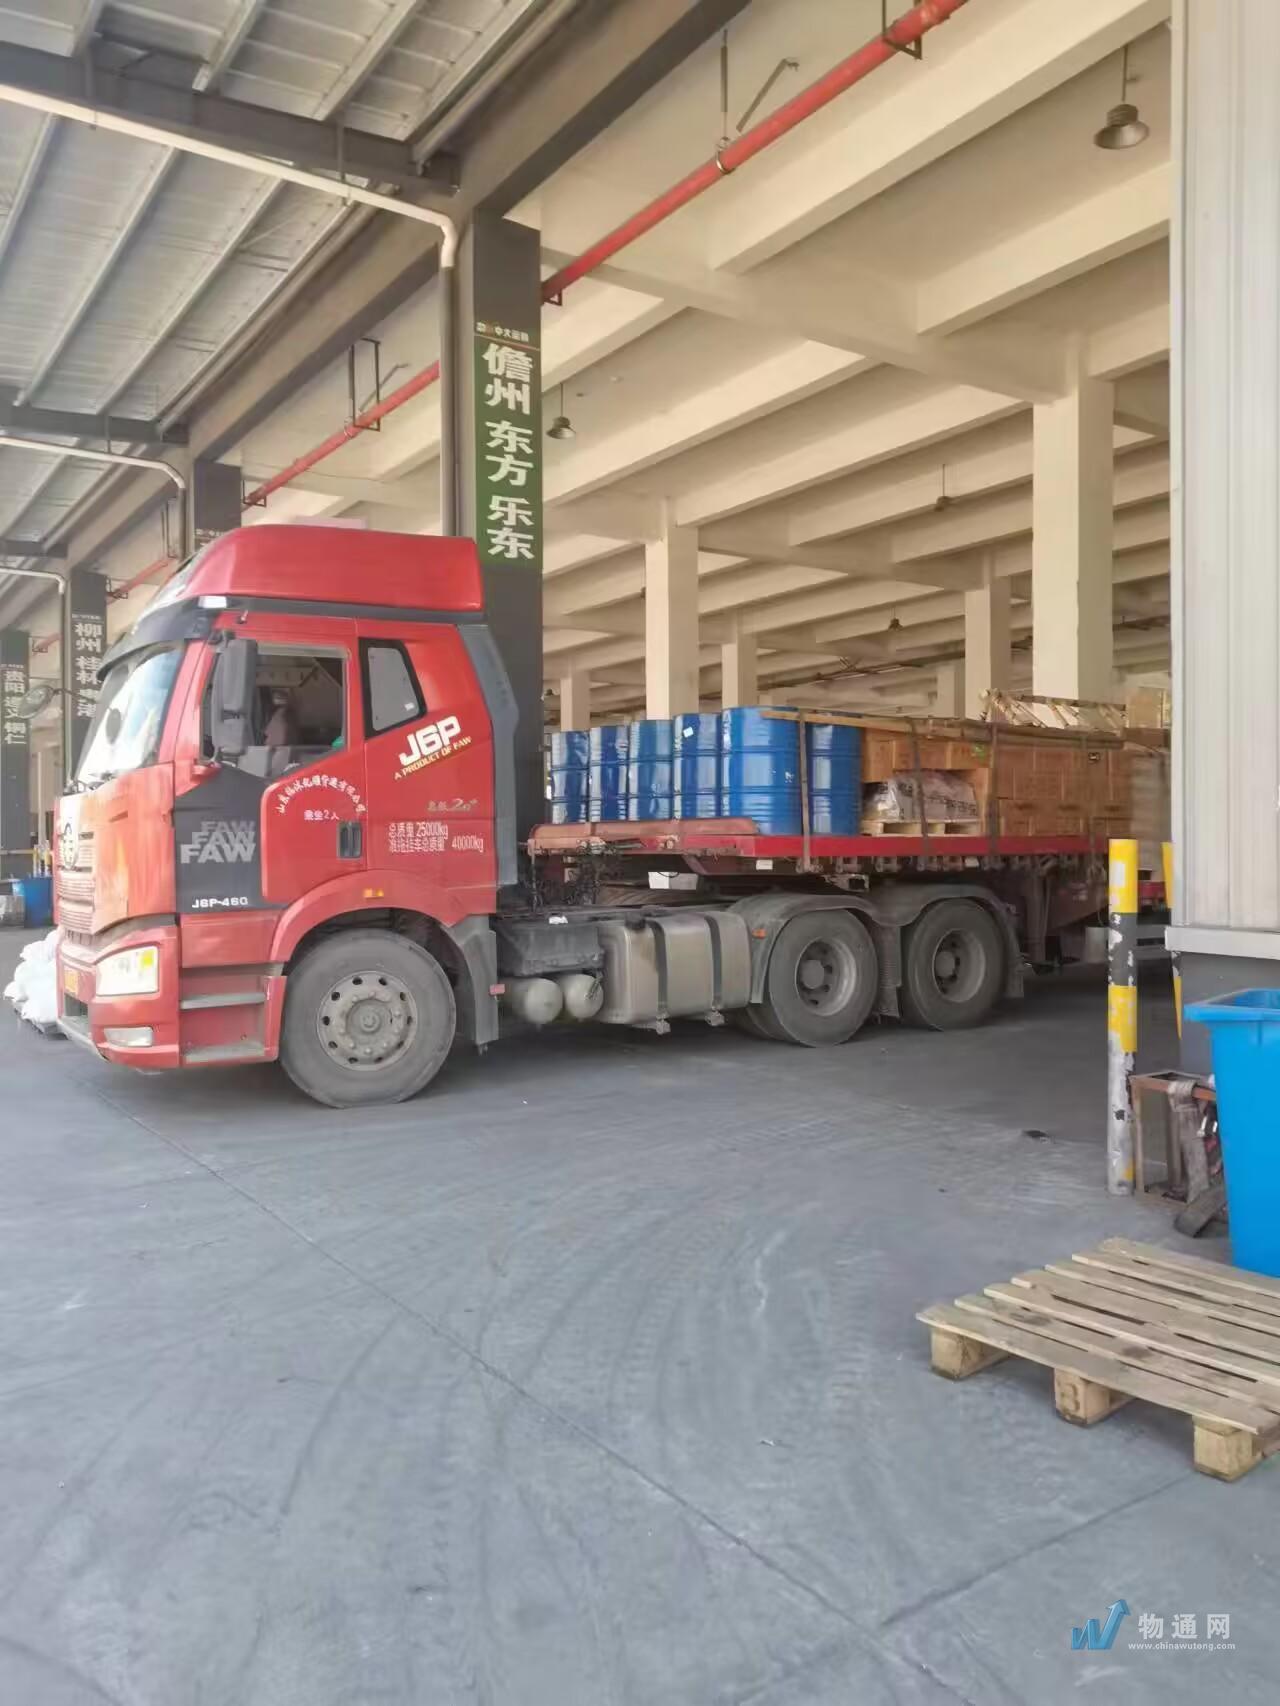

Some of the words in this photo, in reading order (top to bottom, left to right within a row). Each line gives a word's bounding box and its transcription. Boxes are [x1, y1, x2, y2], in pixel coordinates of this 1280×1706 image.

[482, 343, 533, 415] 儋州
[485, 420, 534, 486] 东方
[487, 495, 535, 559] 乐东
[74, 622, 102, 653] 柳州
[394, 772, 402, 780] A
[401, 751, 440, 776] PRODUCT
[440, 745, 452, 756] OF
[452, 735, 472, 750] FAW
[398, 715, 461, 766] J6P
[191, 831, 256, 846] FAW
[200, 820, 256, 833] FAW
[180, 843, 257, 864] FAW
